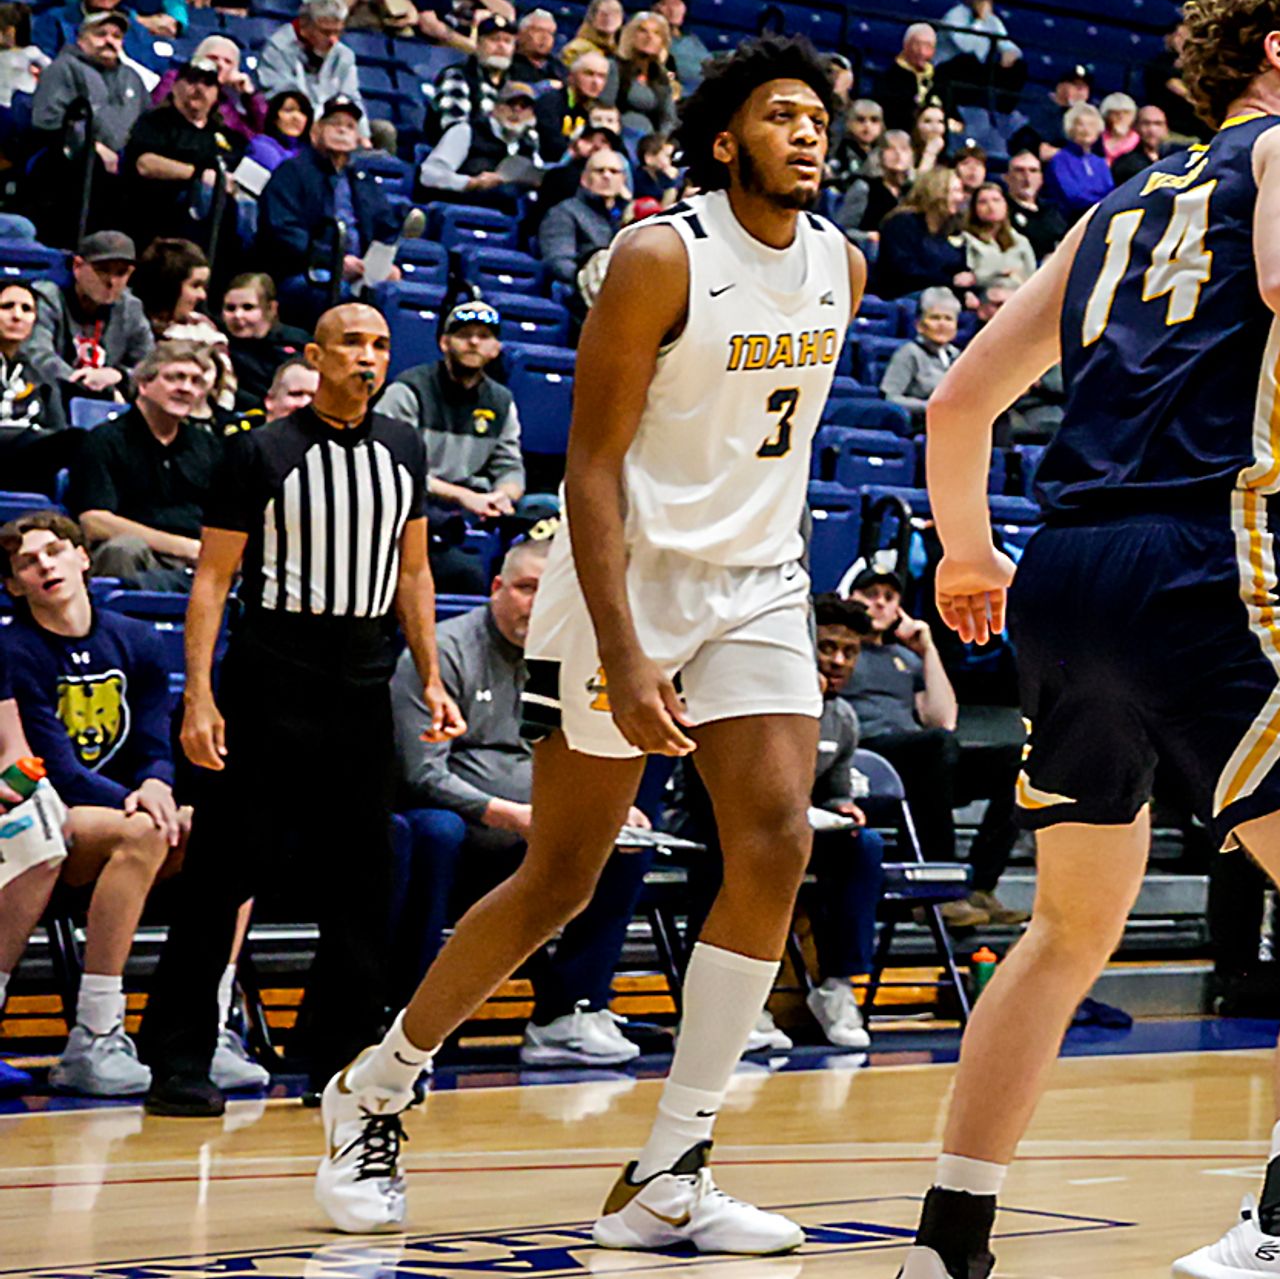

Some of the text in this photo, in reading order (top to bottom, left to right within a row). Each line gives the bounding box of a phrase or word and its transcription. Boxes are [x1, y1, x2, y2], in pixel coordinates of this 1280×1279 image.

[1082, 179, 1217, 348] 14
[726, 328, 838, 371] IDAHO
[756, 386, 800, 460] 3
